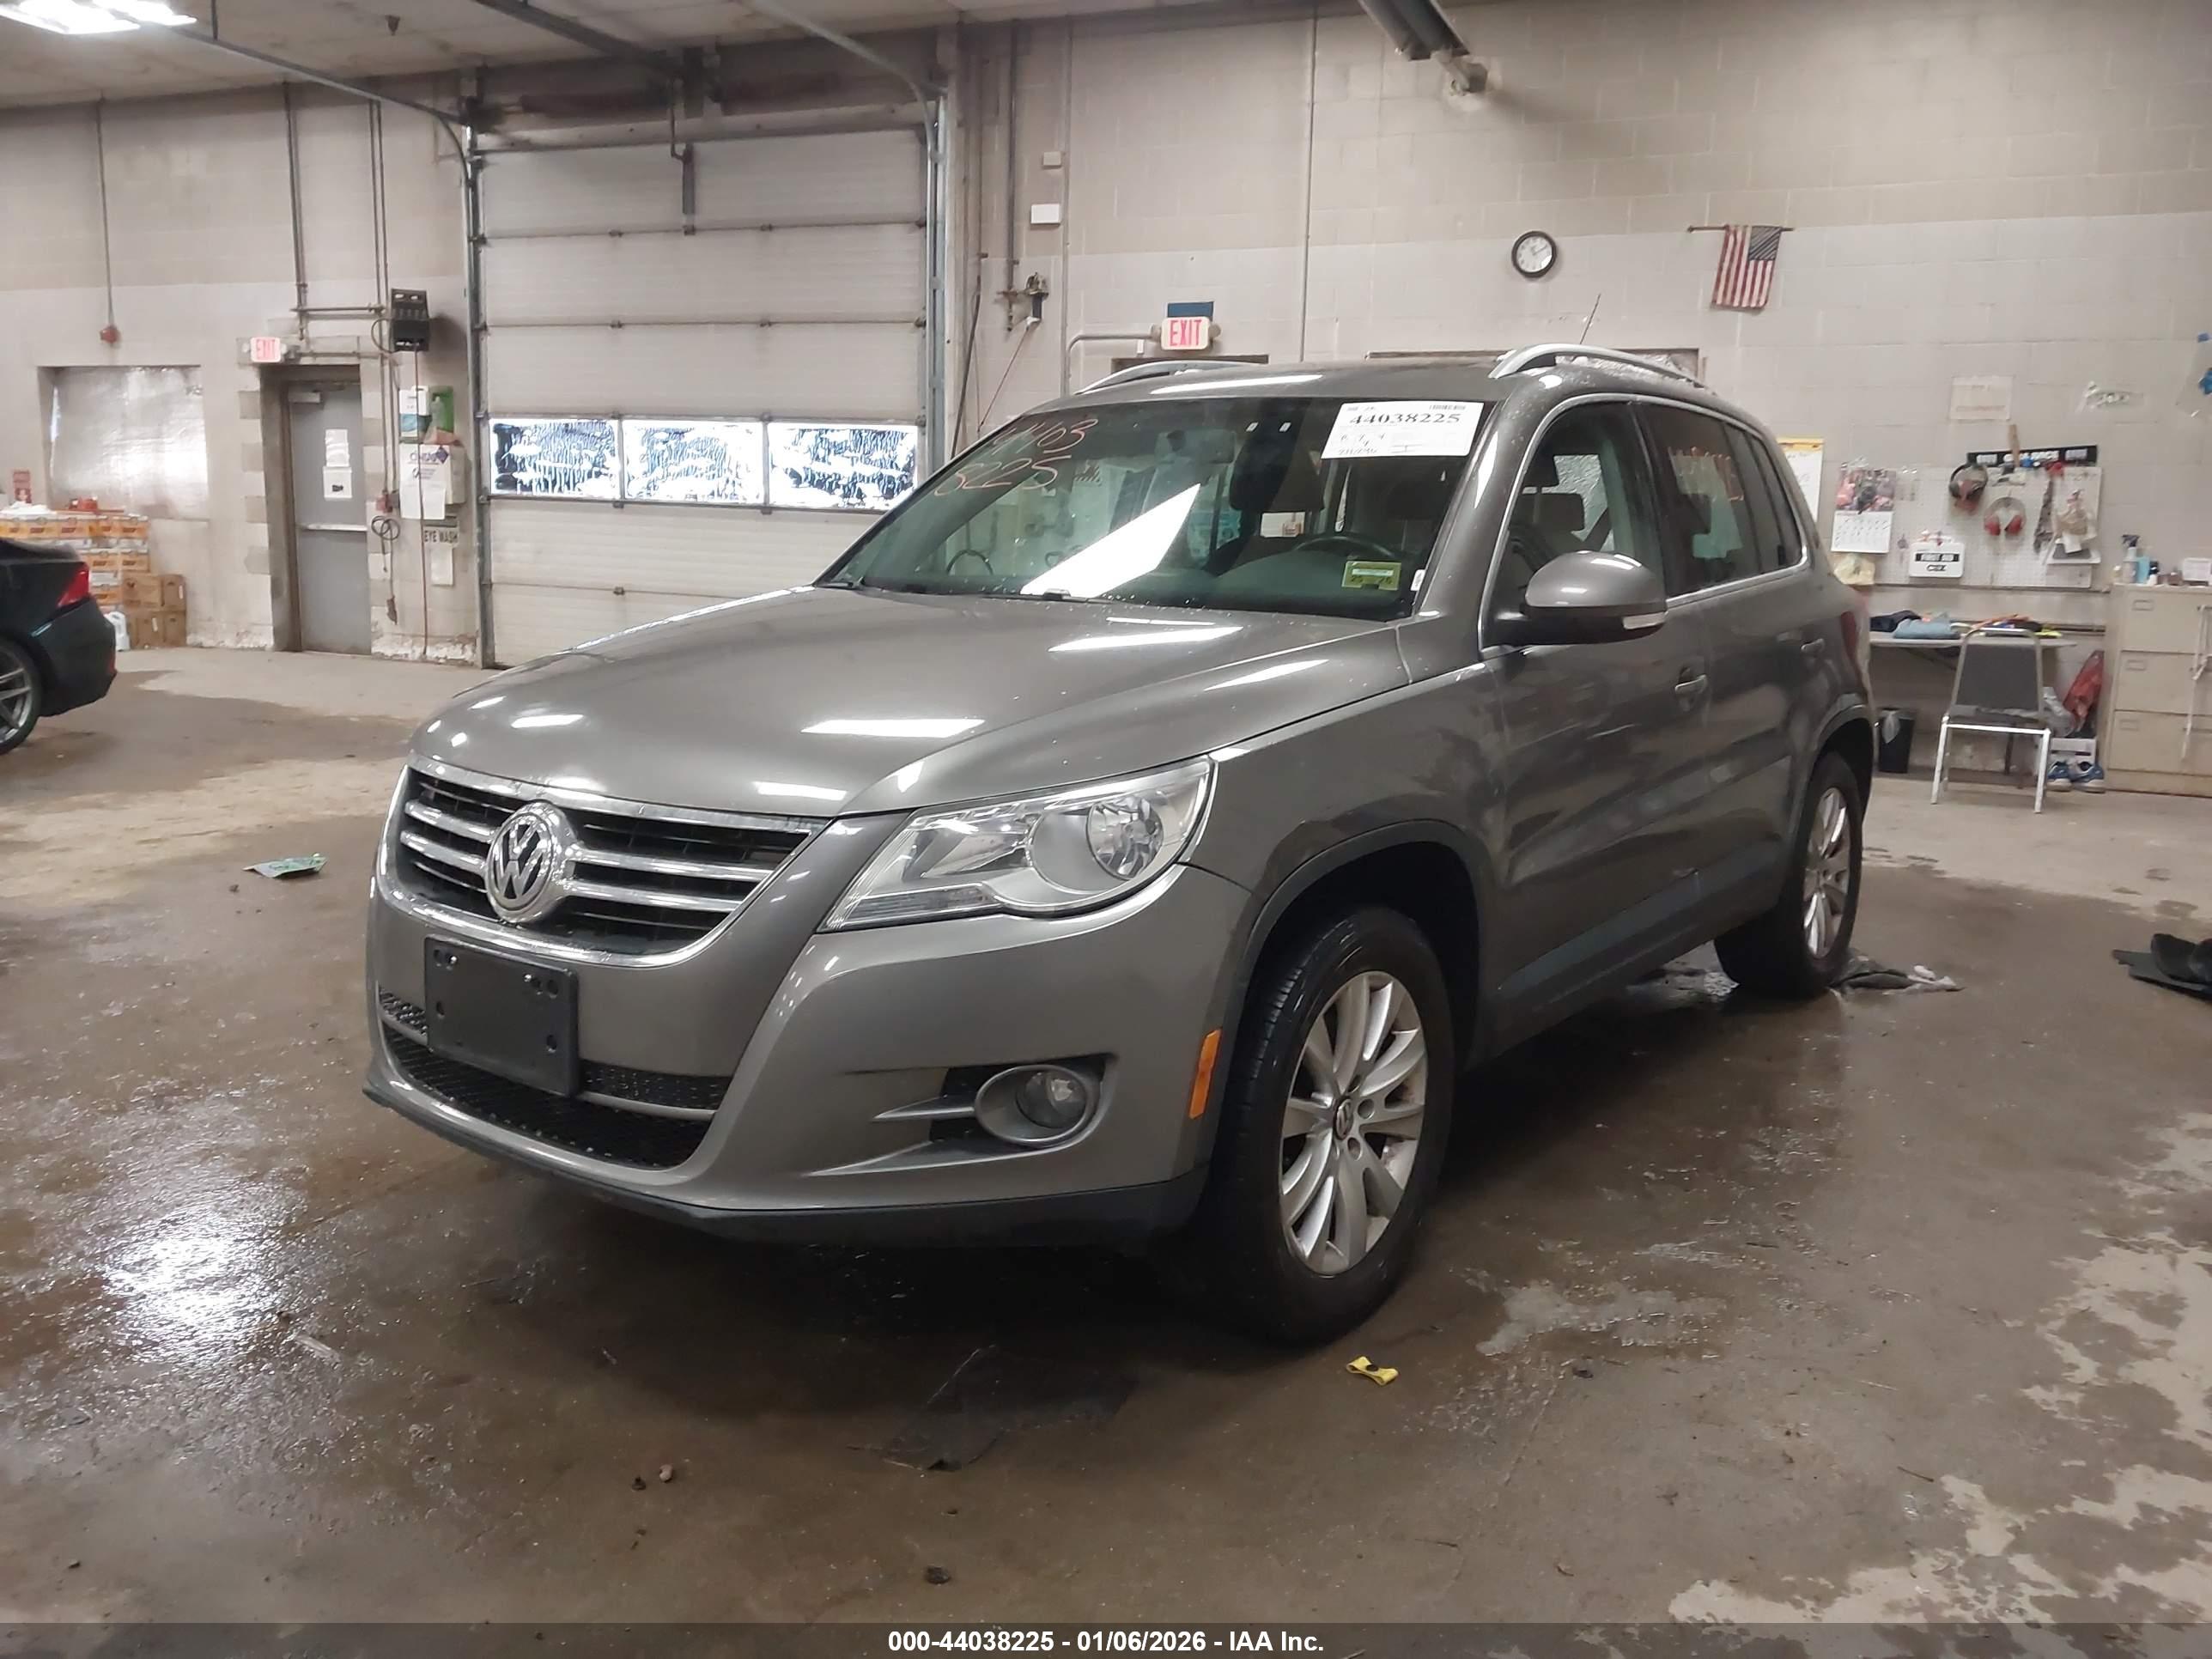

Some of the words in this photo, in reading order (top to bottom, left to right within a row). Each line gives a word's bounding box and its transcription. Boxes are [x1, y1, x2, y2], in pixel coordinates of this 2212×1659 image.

[1169, 319, 1203, 347] EXIT
[255, 338, 276, 360] EXIT
[1349, 412, 1462, 424] 44038225
[491, 815, 552, 908] VW
